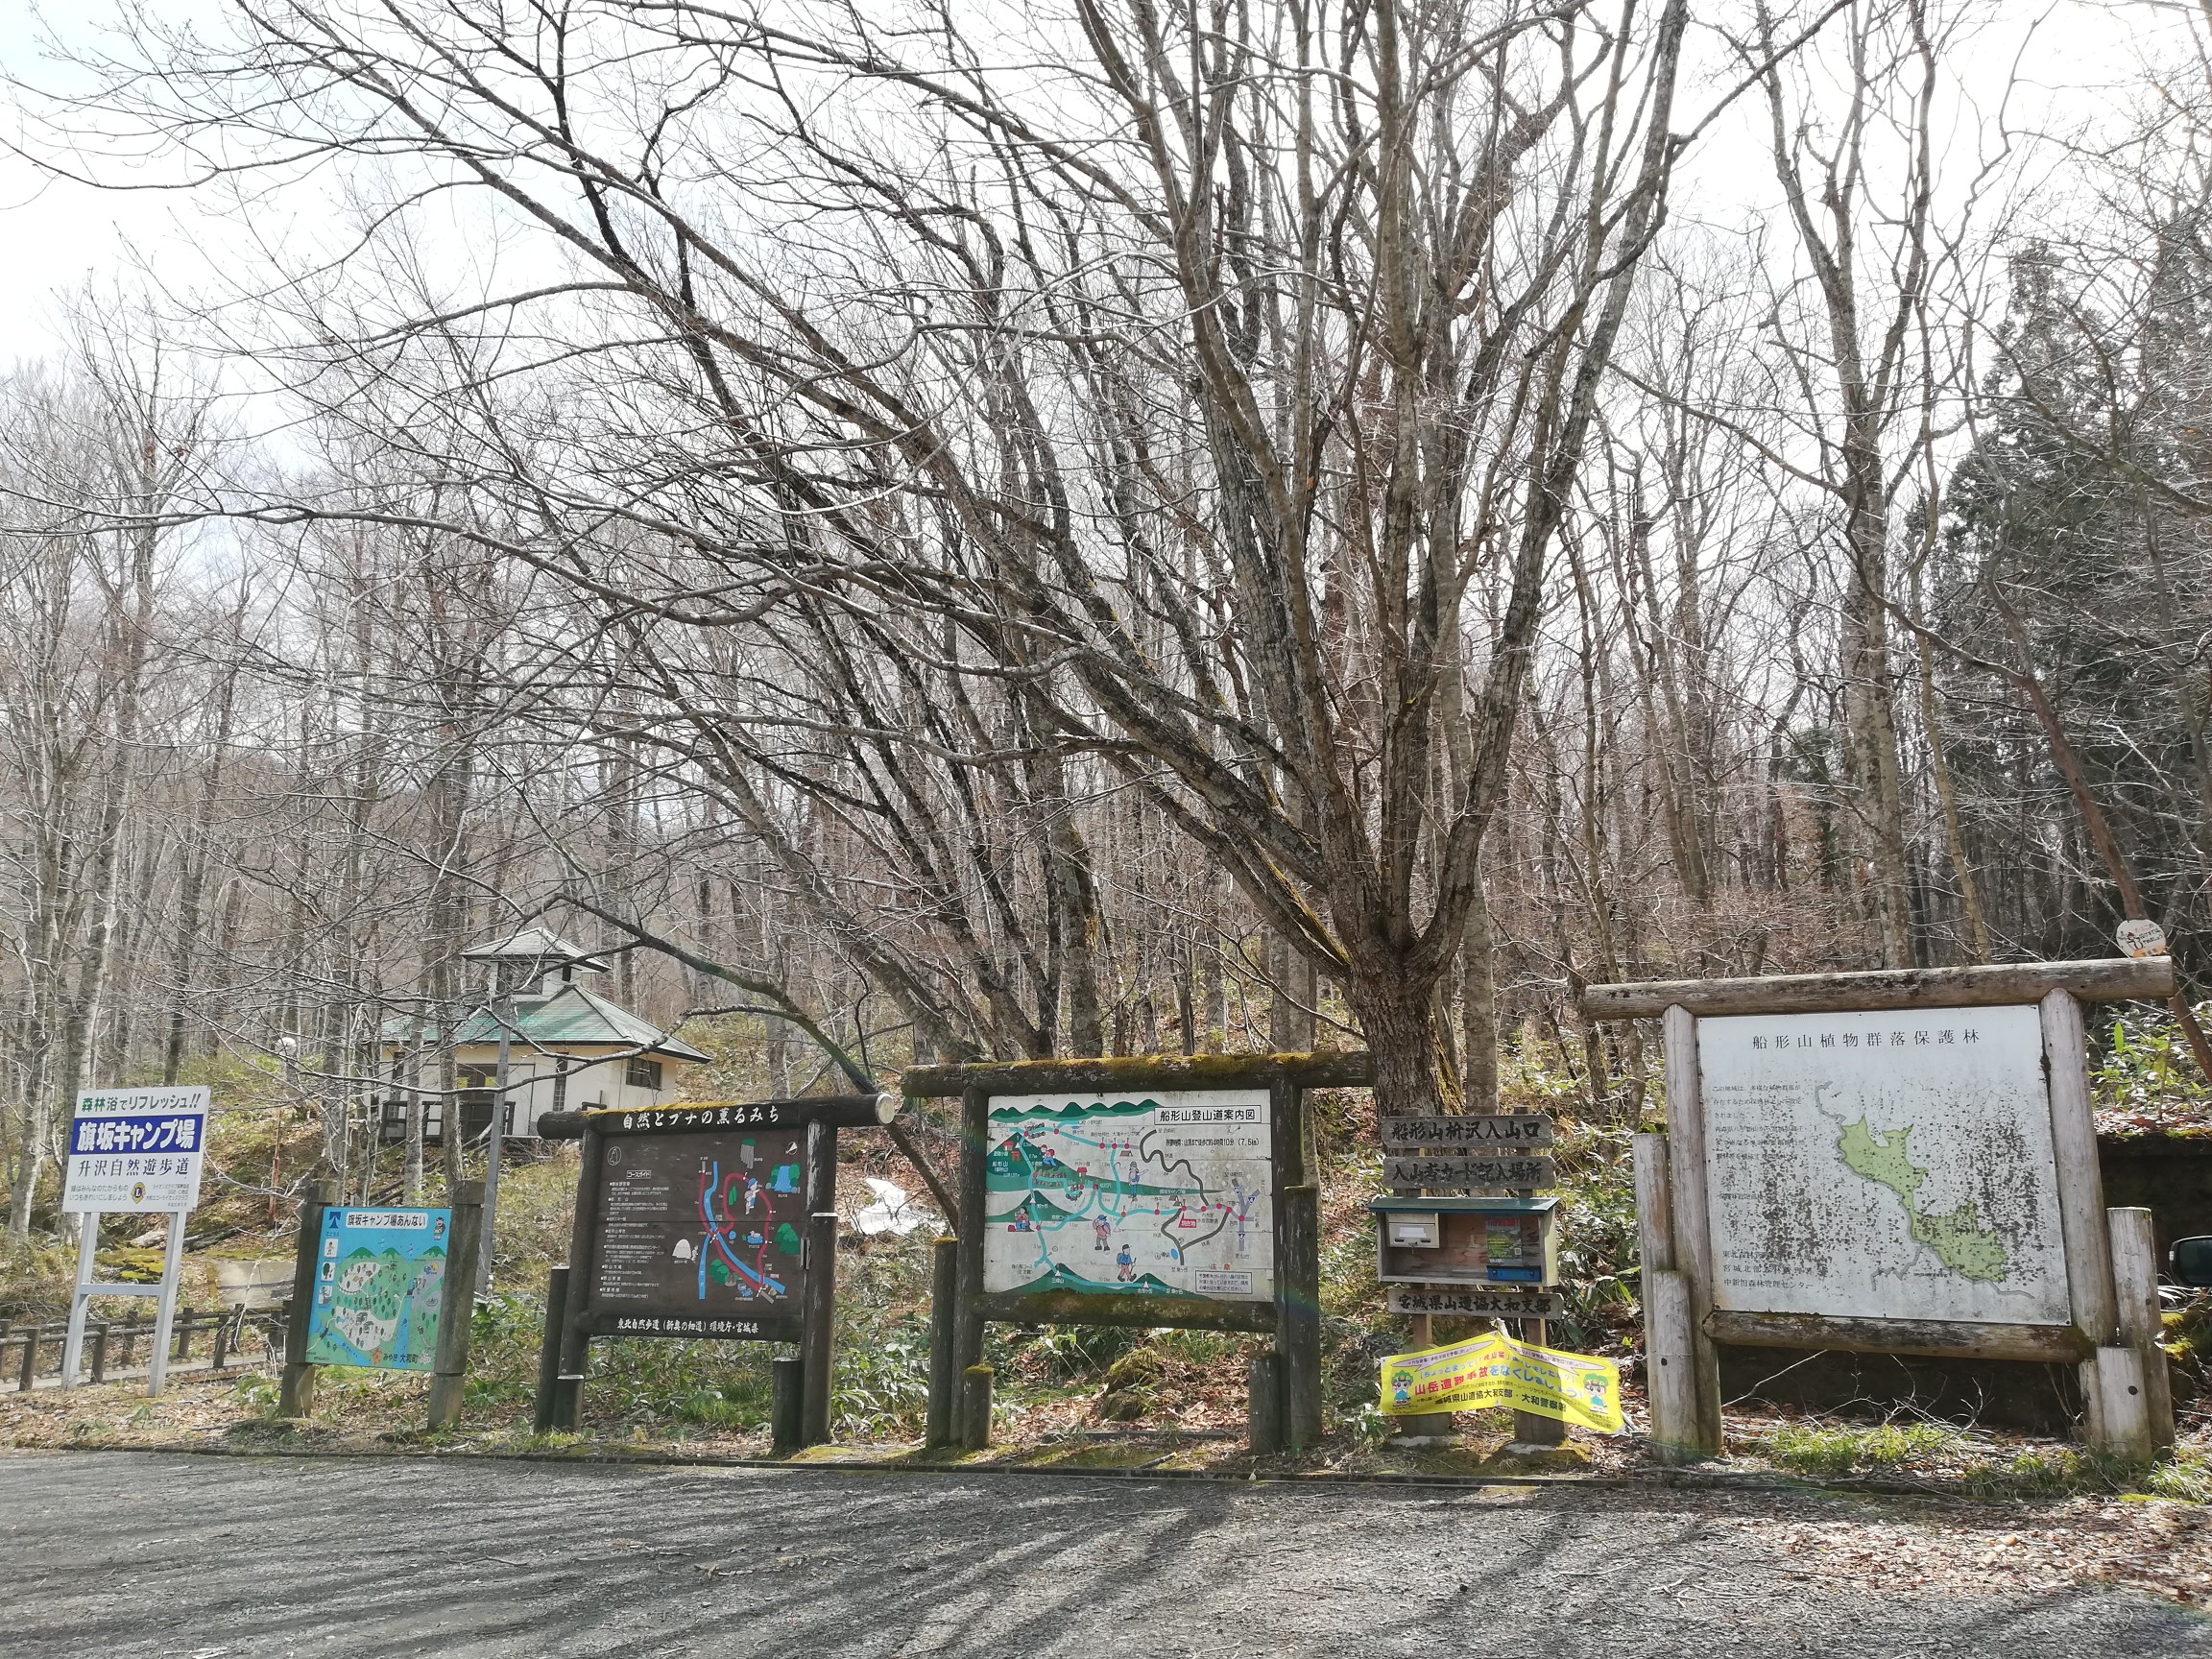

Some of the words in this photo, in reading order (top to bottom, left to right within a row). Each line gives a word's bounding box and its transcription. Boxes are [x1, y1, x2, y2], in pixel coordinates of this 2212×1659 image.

[1751, 1028, 1980, 1050] 船形山植物群落保護林
[623, 1104, 780, 1130] 自然とブナの薫るみち
[1160, 1109, 1256, 1122] 船形山登山道案内図
[77, 1118, 196, 1151] 旗坂キャンプ場
[78, 1158, 190, 1177] 升沢自然遊歩道
[347, 1214, 426, 1227] 旗坂キャンプ場あんない
